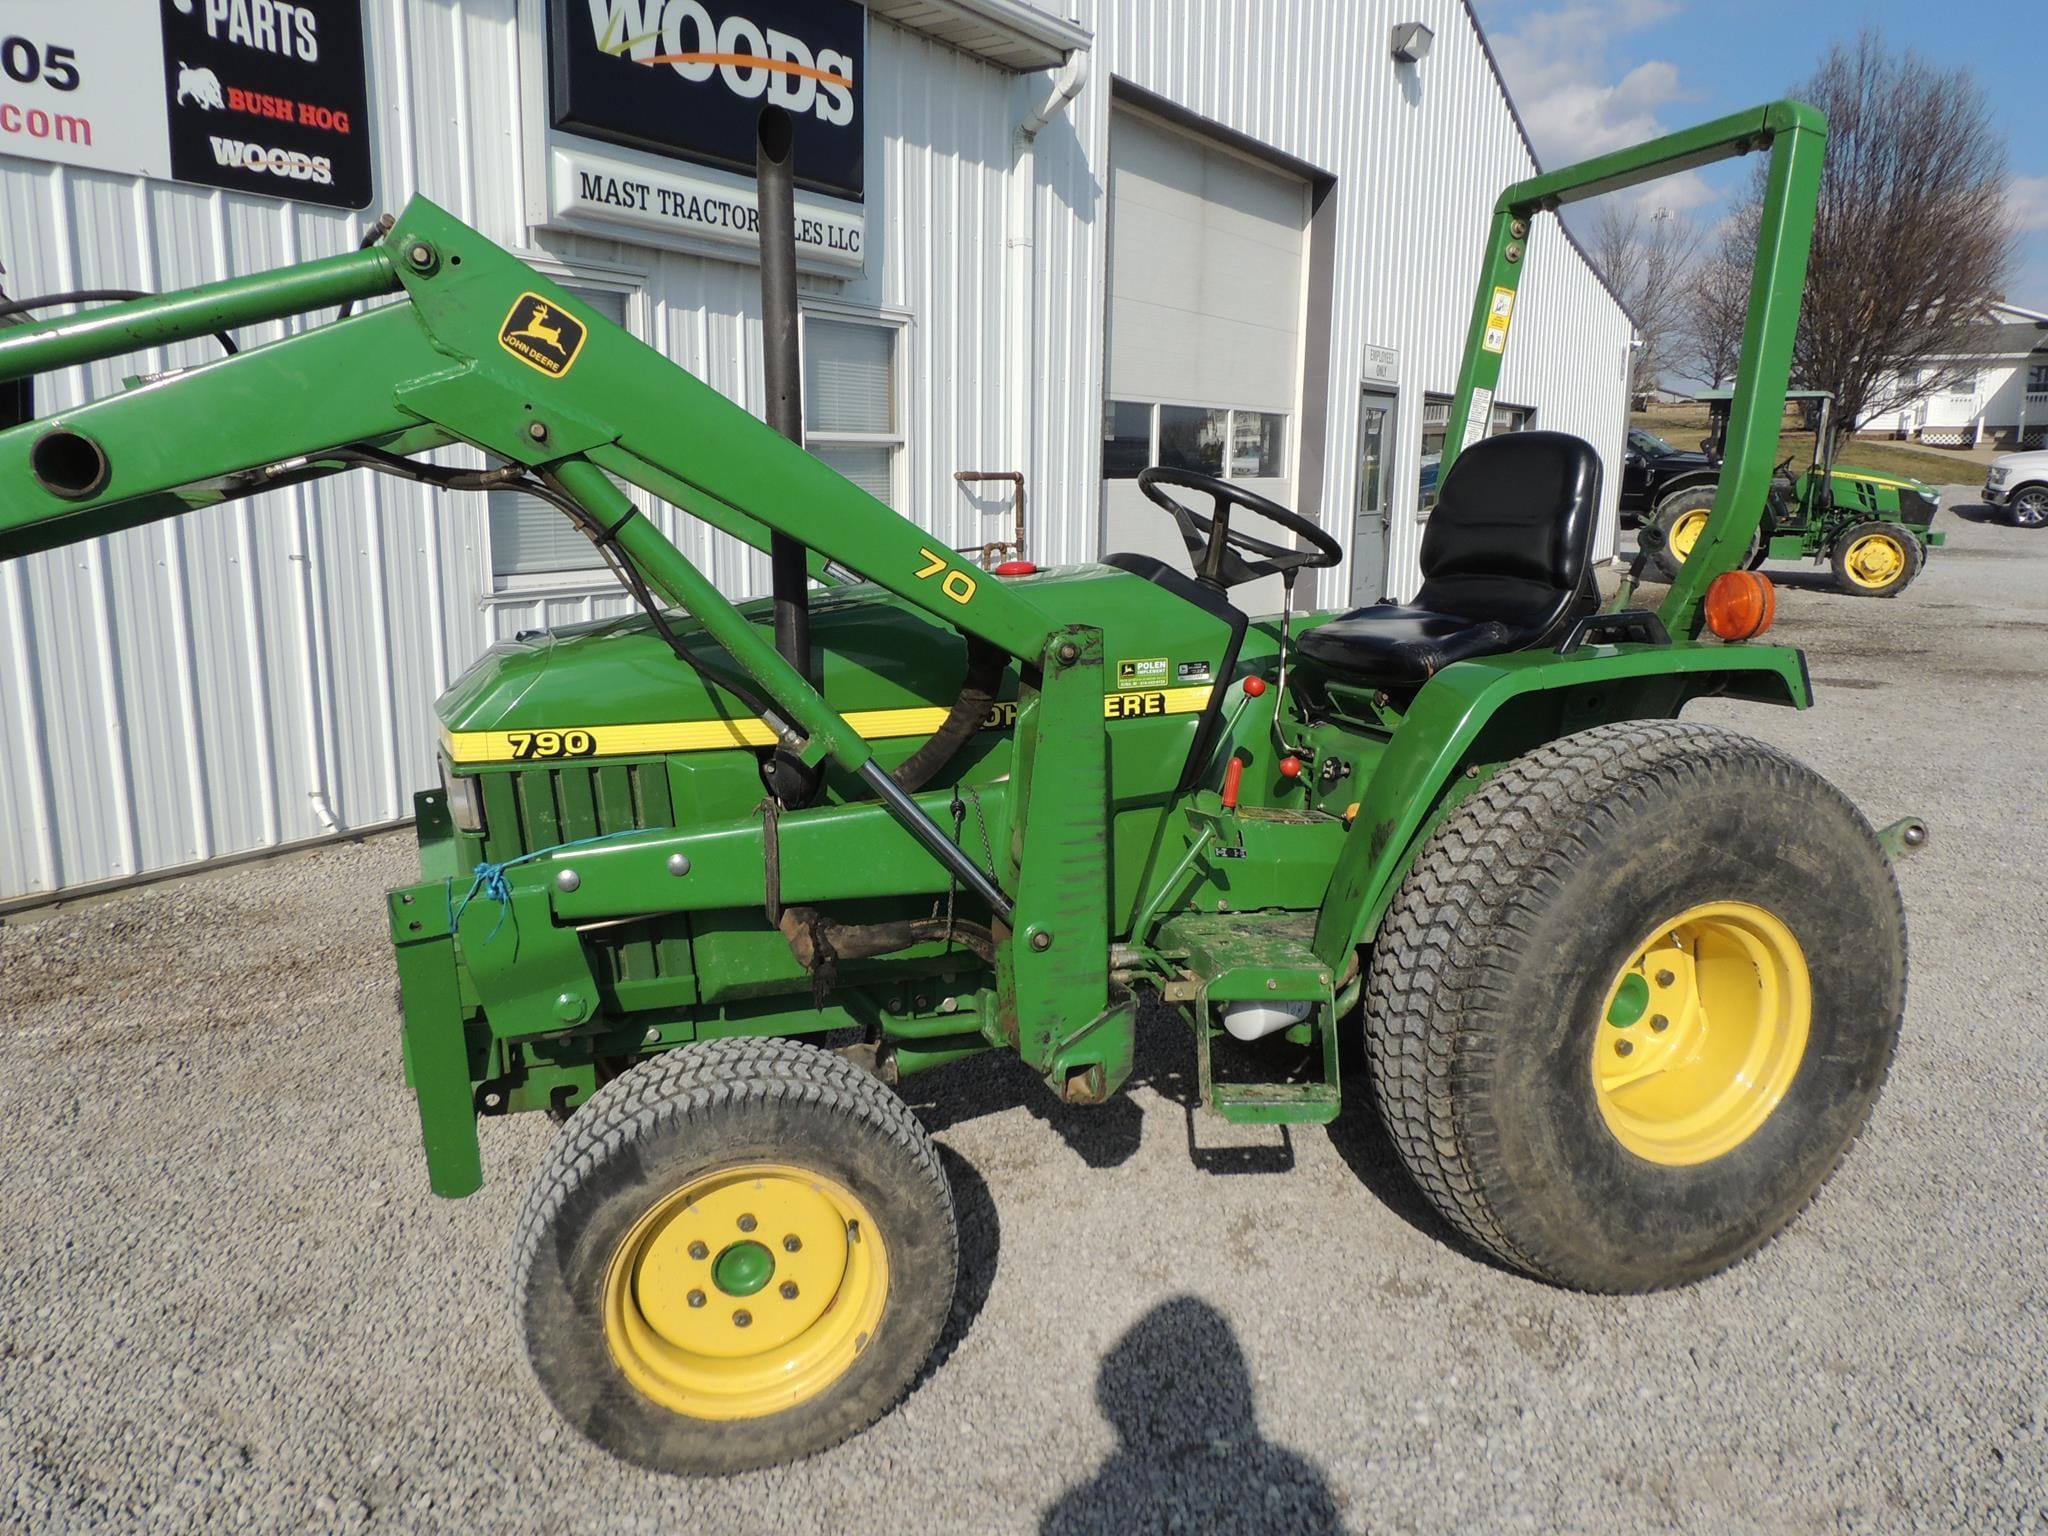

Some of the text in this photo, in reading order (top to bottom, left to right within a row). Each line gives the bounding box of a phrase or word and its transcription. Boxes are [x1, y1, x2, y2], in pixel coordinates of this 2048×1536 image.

[205, 0, 318, 62] PARTS
[588, 0, 854, 126] WOODS
[227, 87, 349, 134] BUSH HOG
[209, 136, 332, 185] WOODS
[580, 172, 650, 211] MAST
[657, 189, 760, 233] TRACTOR
[828, 225, 860, 252] LLC
[503, 335, 560, 372] JOHN DEERE
[912, 546, 977, 605] 70
[1137, 661, 1166, 670] POLEN
[1104, 693, 1163, 718] ERE
[508, 730, 595, 759] 790
